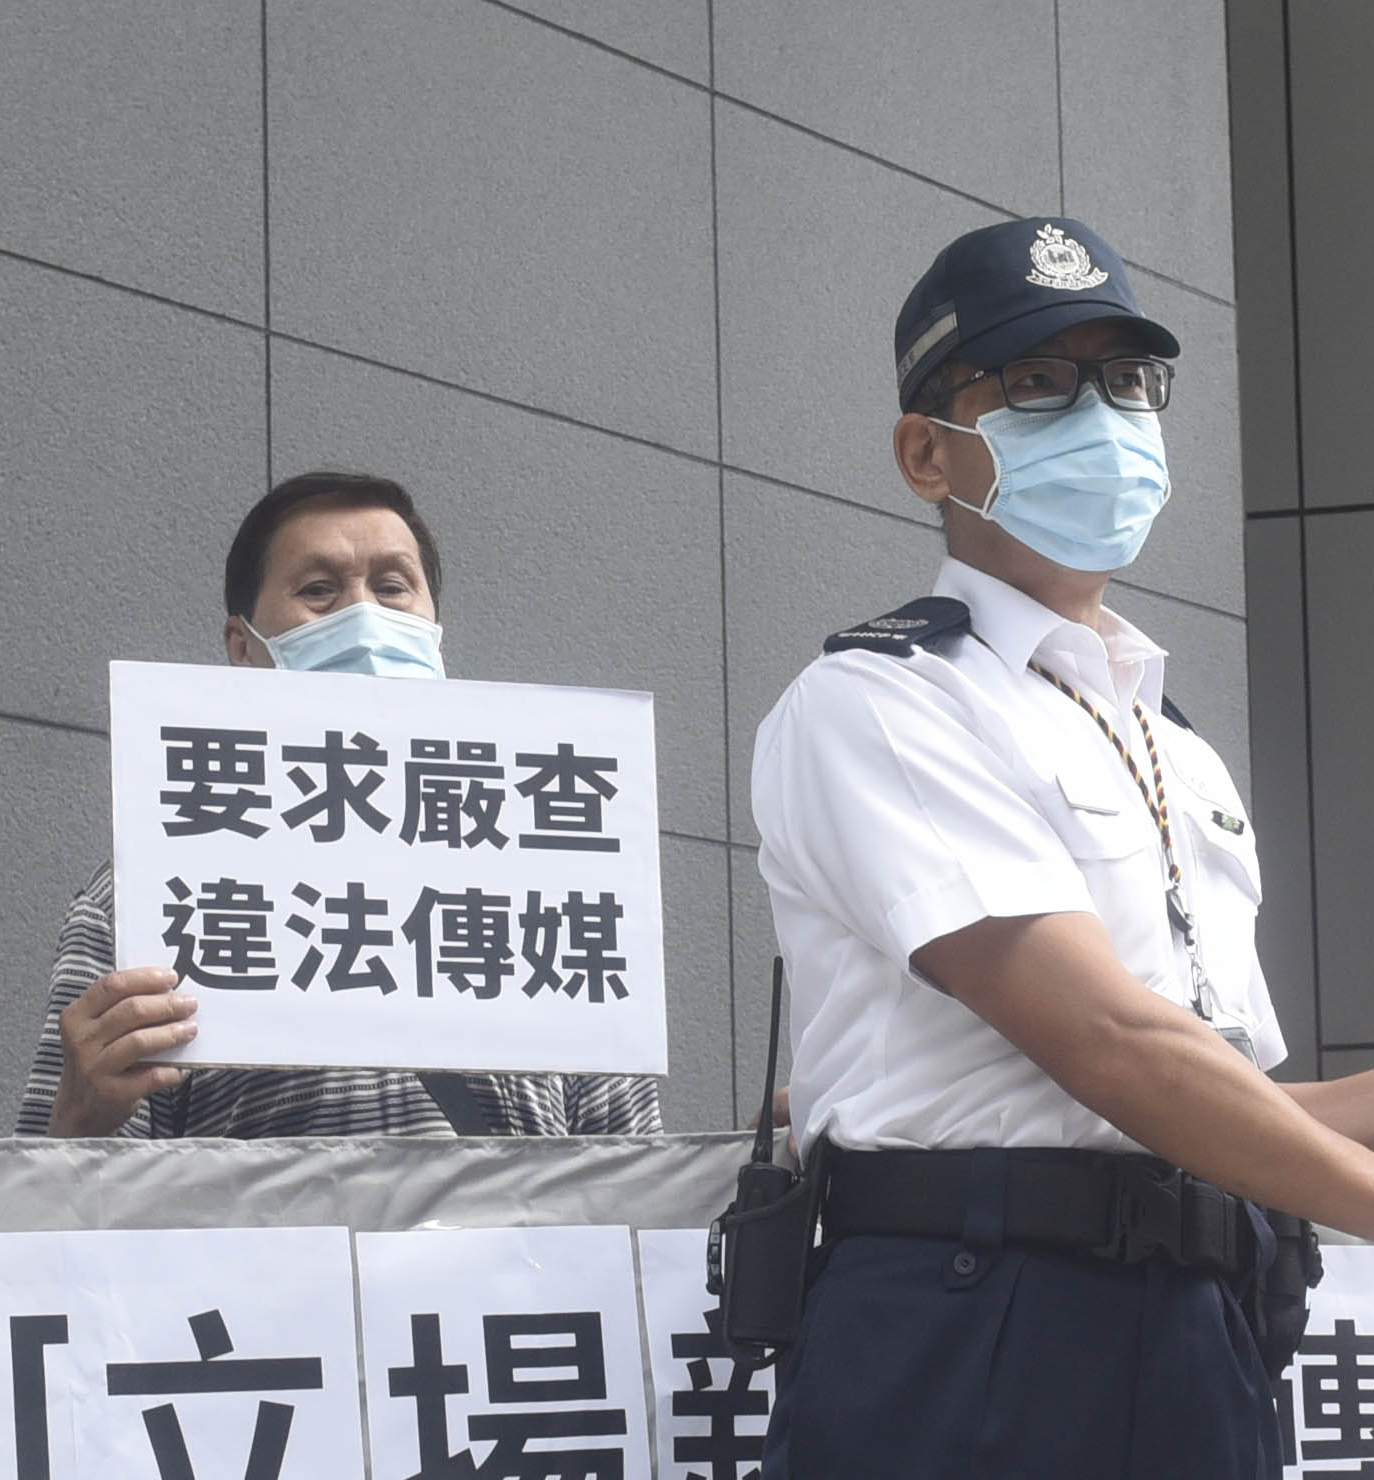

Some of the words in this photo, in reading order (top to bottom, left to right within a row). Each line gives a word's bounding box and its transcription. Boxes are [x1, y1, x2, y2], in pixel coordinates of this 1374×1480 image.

[159, 726, 622, 853] 要求嚴查
[161, 875, 631, 1004] 違法傳媒
